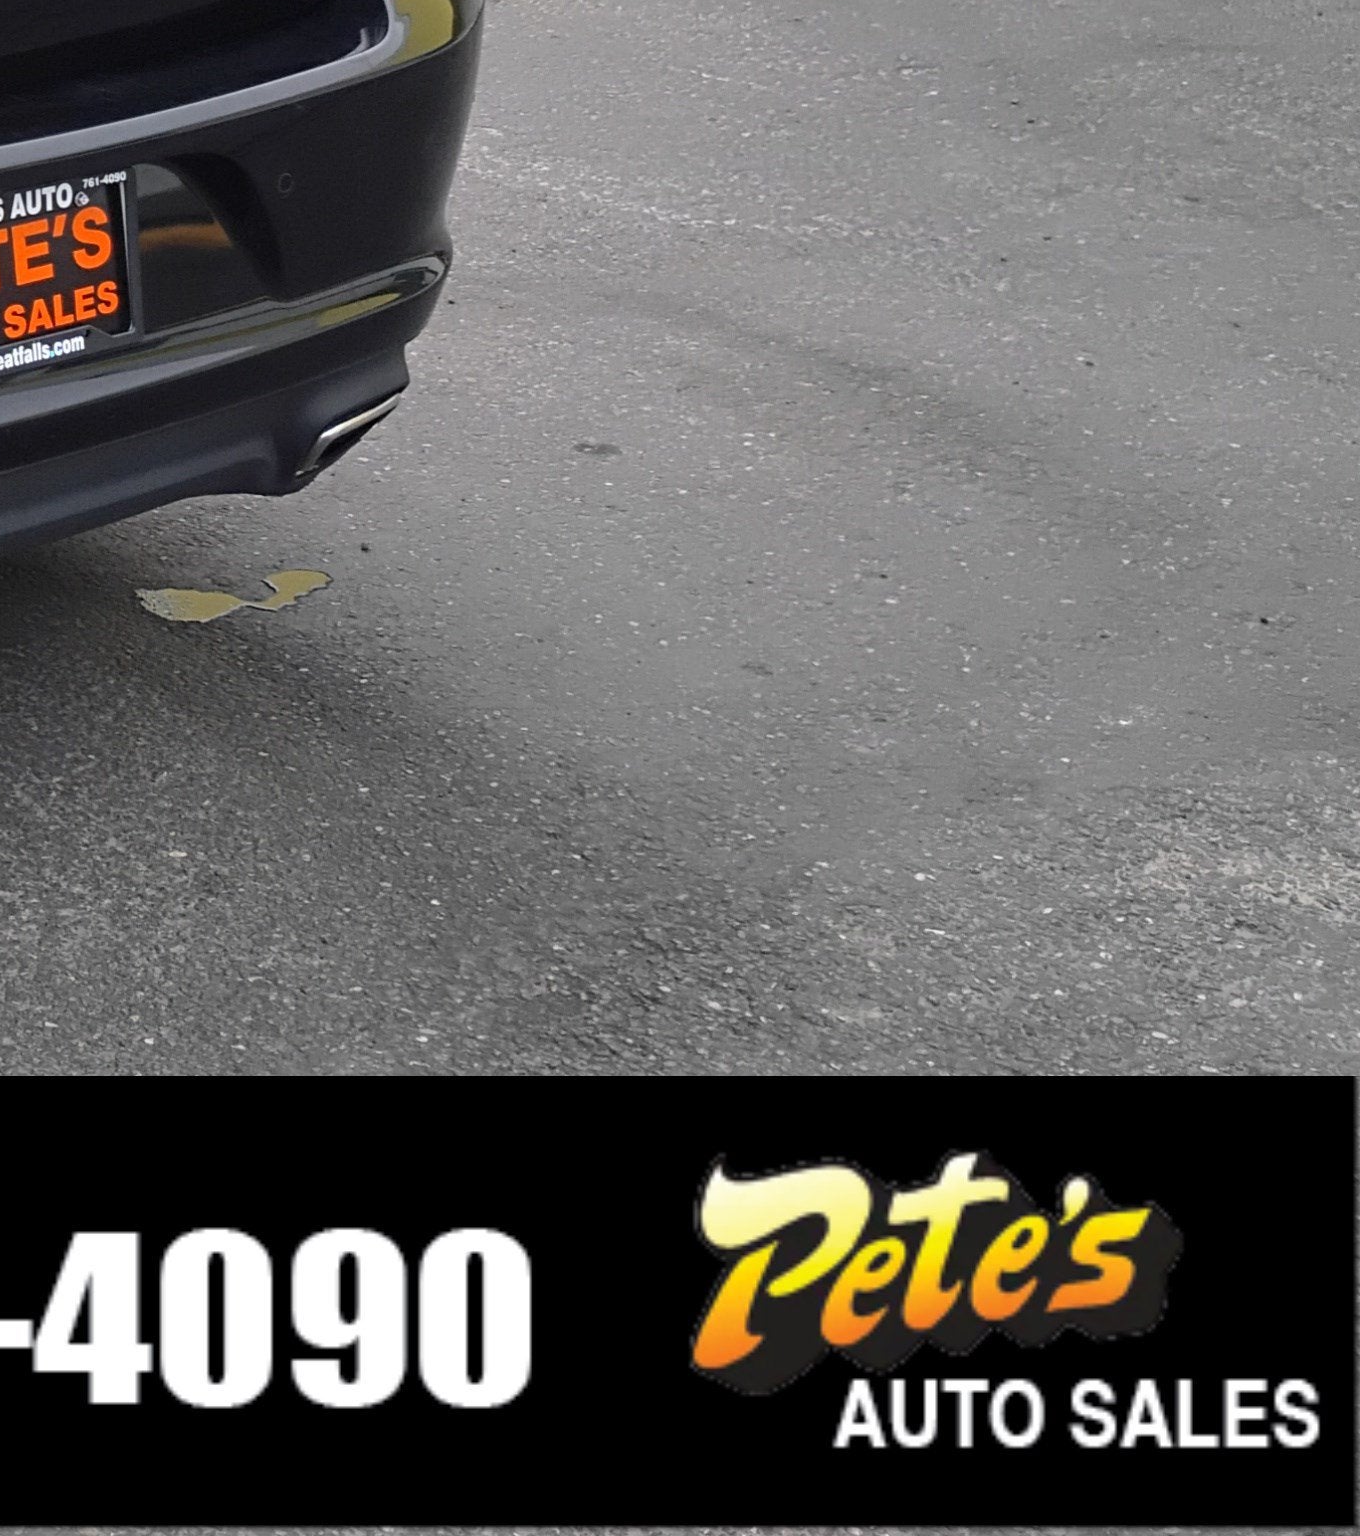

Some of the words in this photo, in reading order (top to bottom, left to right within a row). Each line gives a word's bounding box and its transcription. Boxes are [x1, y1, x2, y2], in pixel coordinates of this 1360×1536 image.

[82, 170, 127, 189] 761-4090
[10, 182, 74, 220] AUTO
[4, 280, 119, 340] SALES
